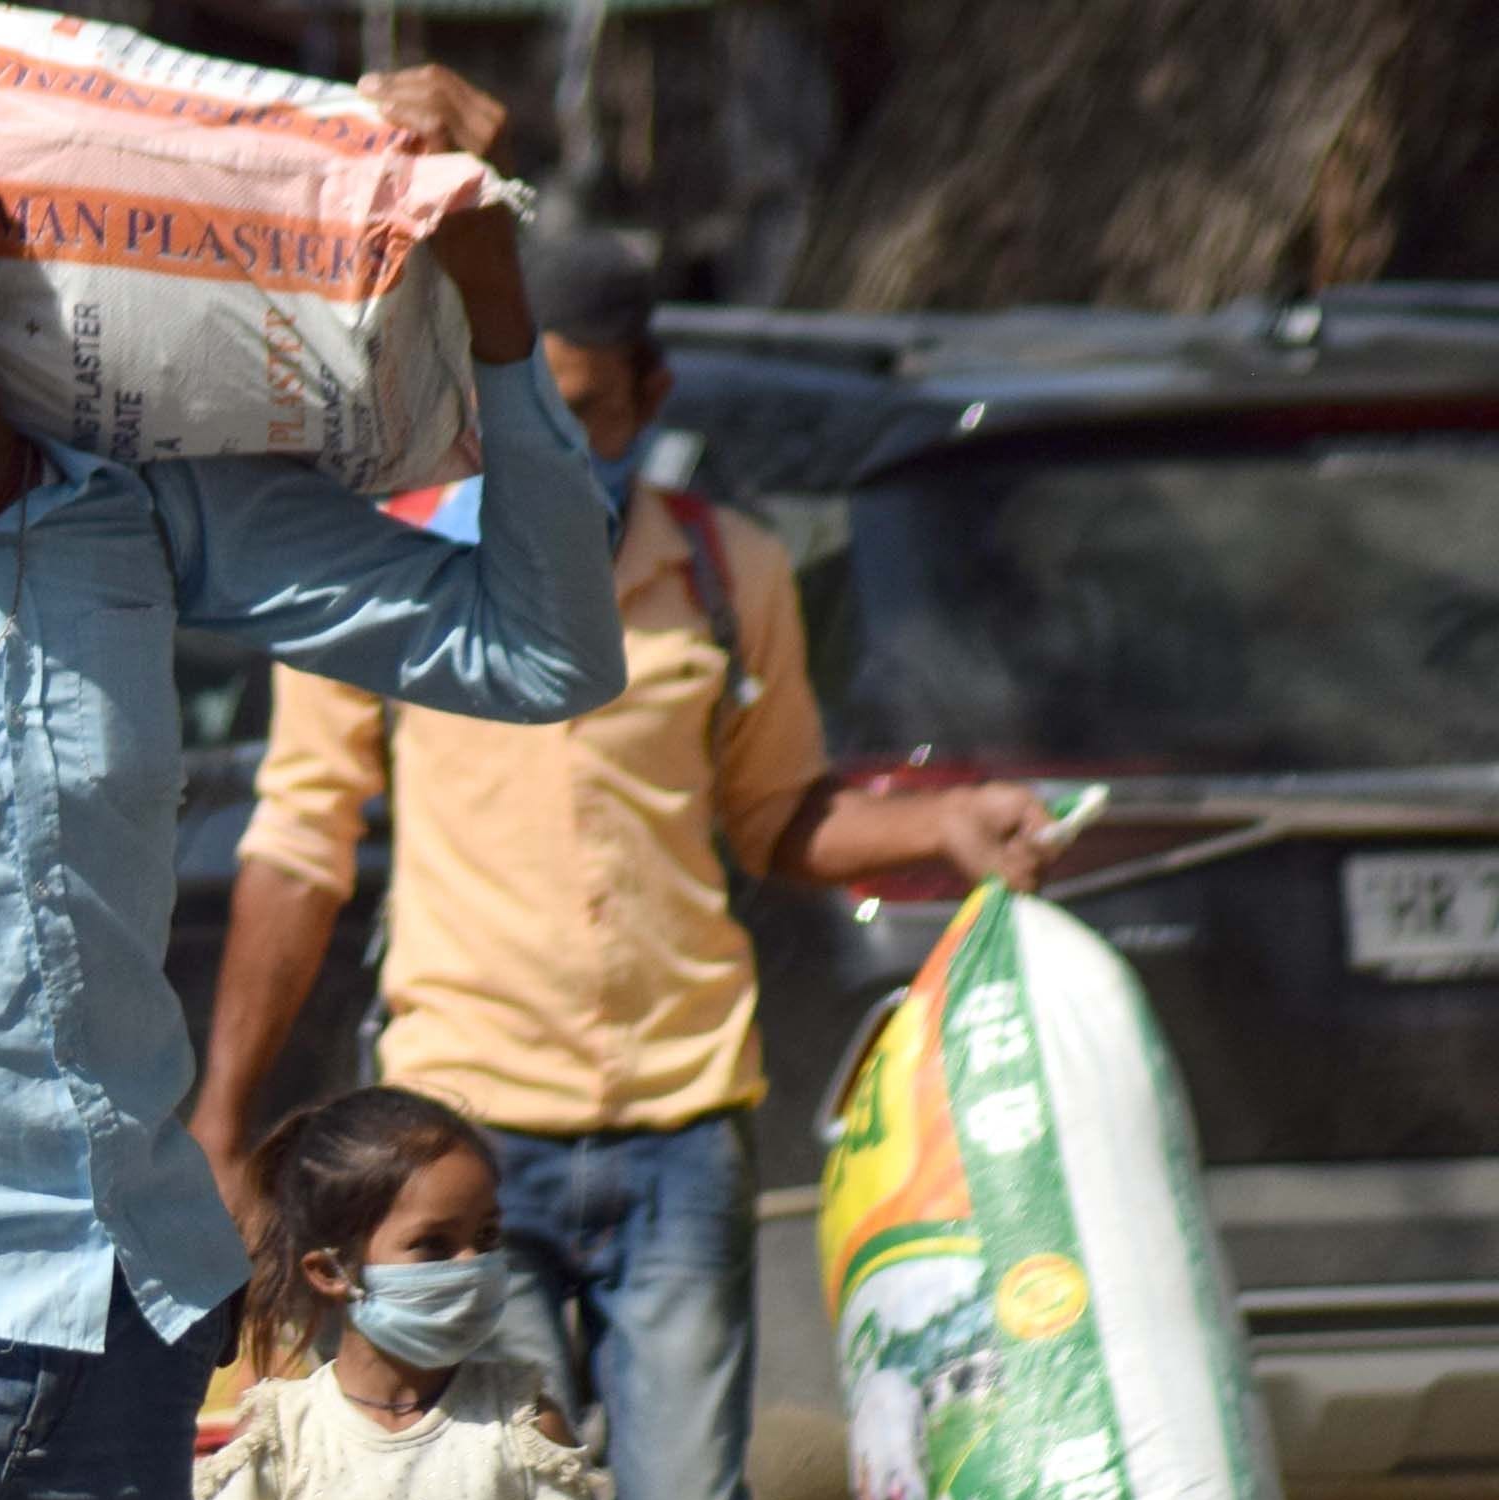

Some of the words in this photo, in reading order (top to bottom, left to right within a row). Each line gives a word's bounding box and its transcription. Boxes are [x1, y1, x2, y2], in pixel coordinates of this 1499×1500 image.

[5, 195, 111, 247] MAN
[72, 303, 102, 415] PLASTER
[107, 389, 146, 459] DRATE
